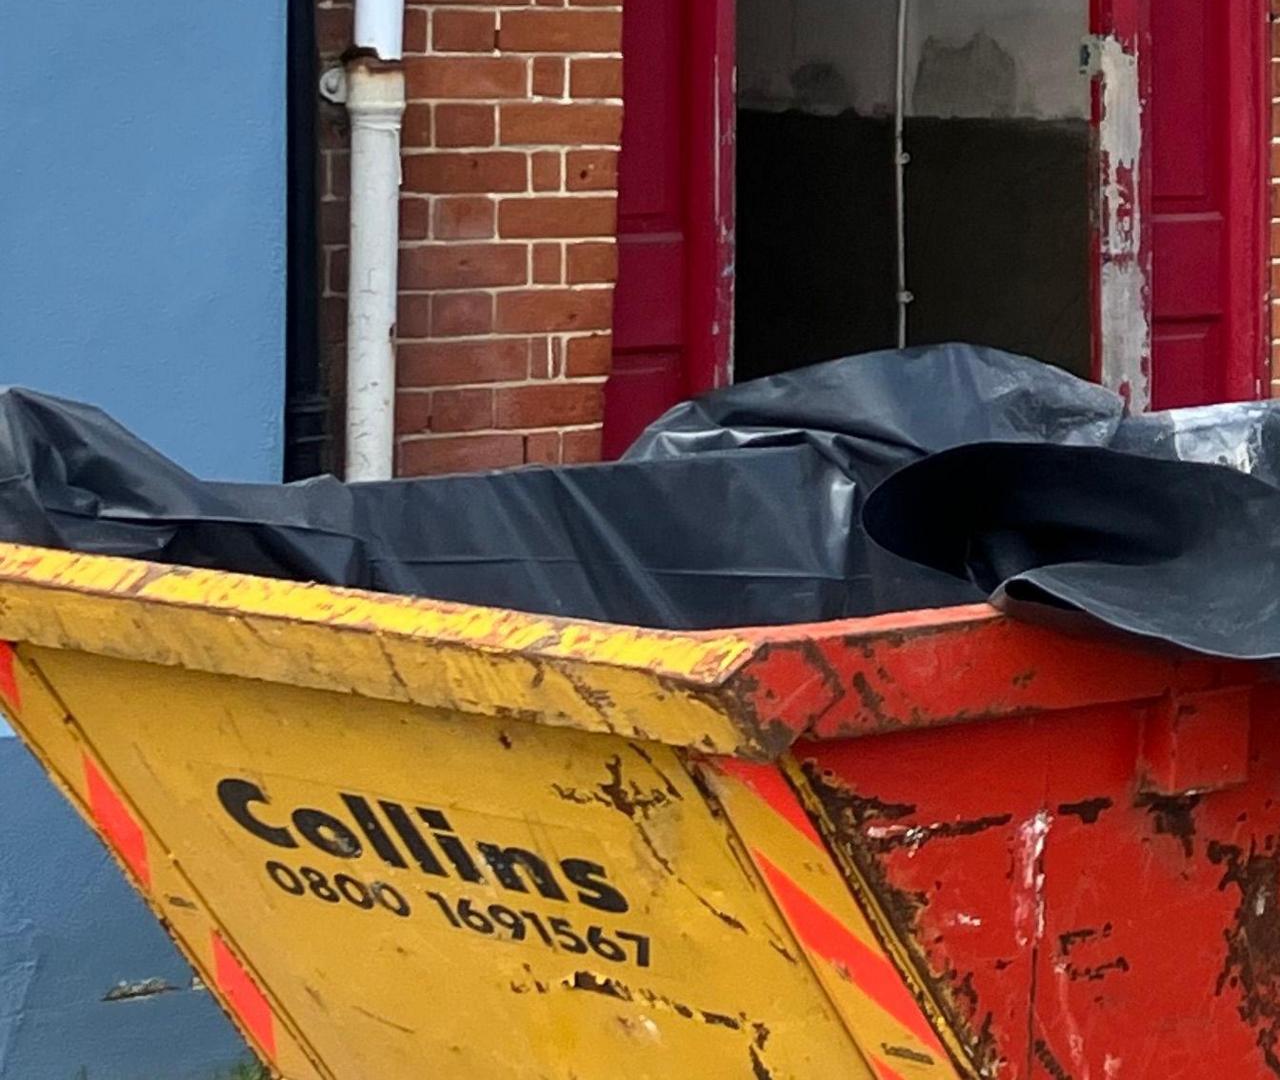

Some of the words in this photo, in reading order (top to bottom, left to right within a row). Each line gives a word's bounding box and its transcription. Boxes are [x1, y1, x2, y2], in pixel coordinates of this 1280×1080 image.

[216, 777, 629, 914] Collins
[266, 859, 410, 918] 0800
[426, 891, 651, 968] 1691567
